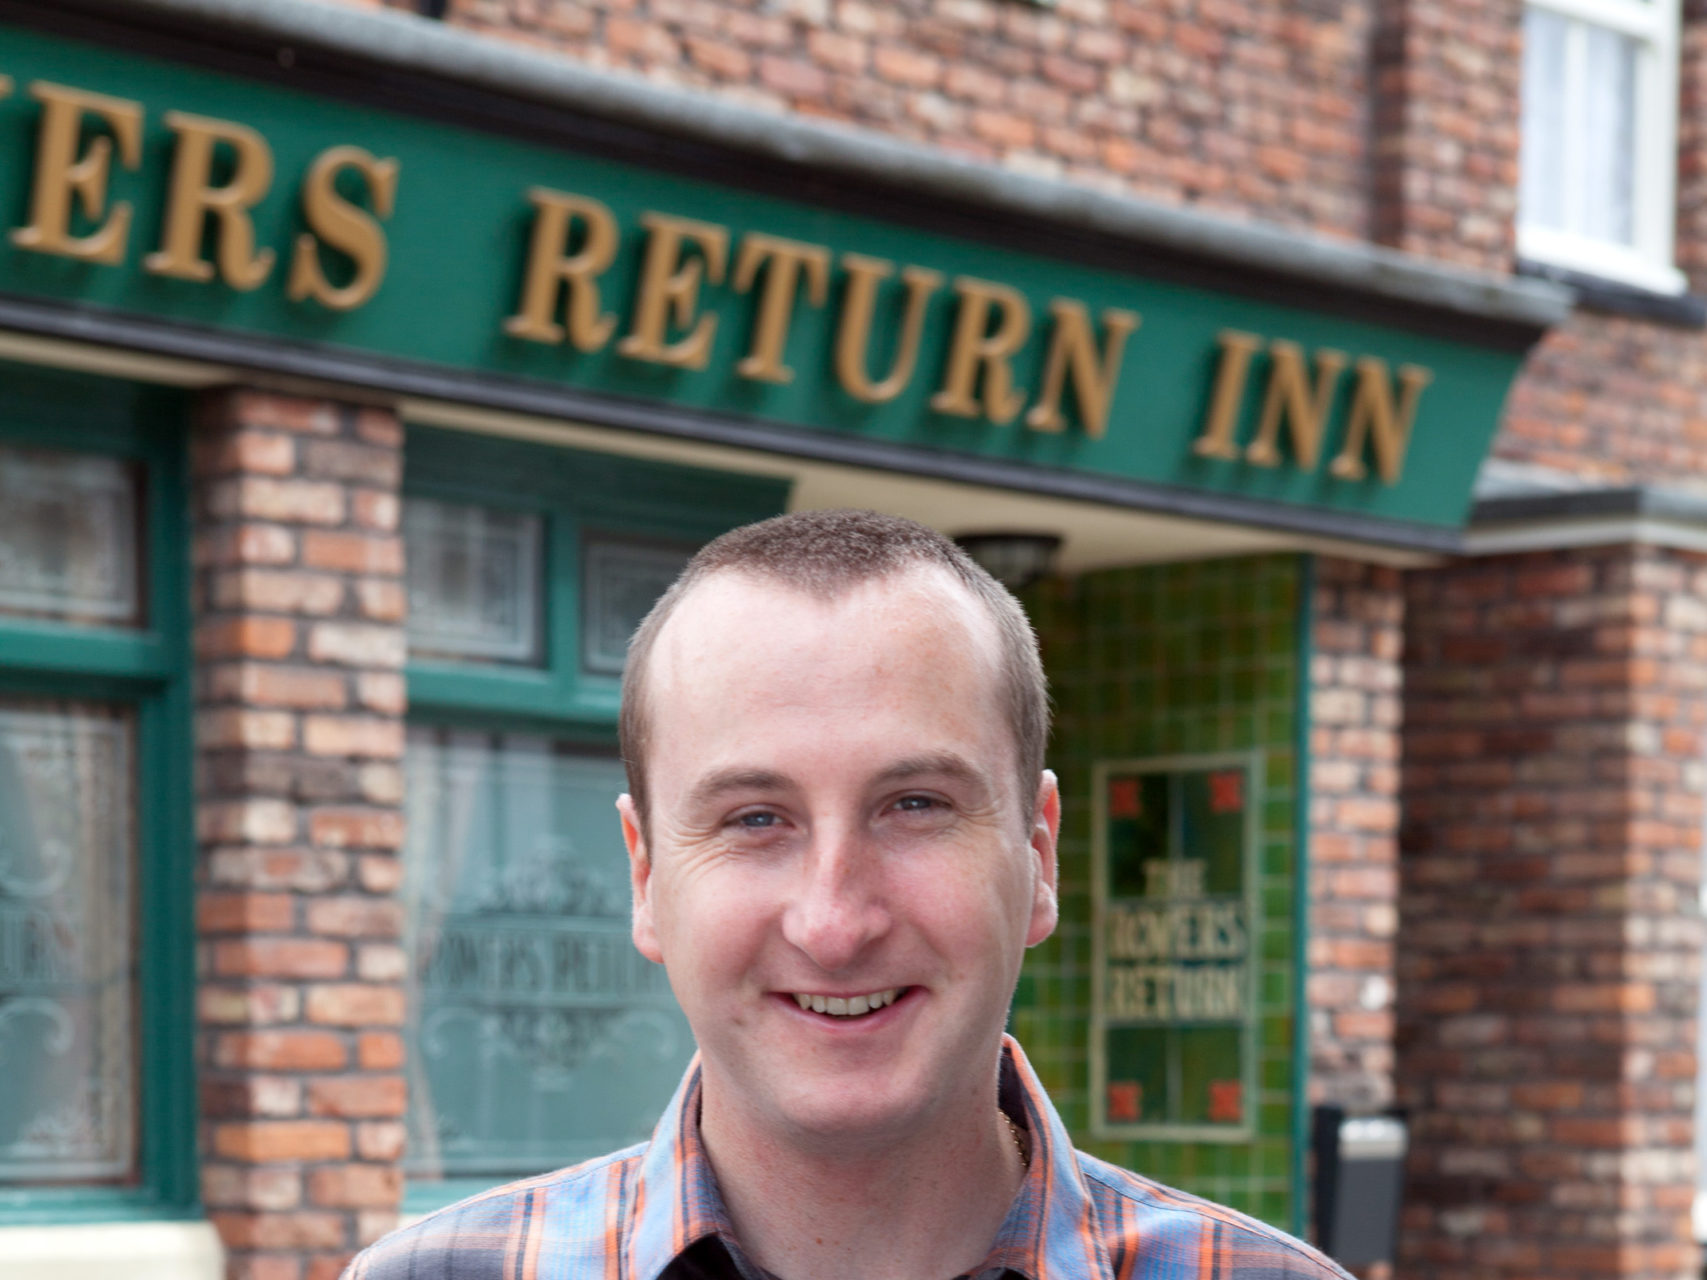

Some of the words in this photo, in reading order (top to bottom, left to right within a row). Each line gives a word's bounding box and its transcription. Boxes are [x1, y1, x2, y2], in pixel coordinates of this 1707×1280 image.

[0, 73, 399, 311] ERS
[504, 184, 1143, 439] RETURN
[1193, 328, 1434, 486] INN
[1108, 903, 1246, 959] ROVERS
[1108, 966, 1242, 1020] RETURN
